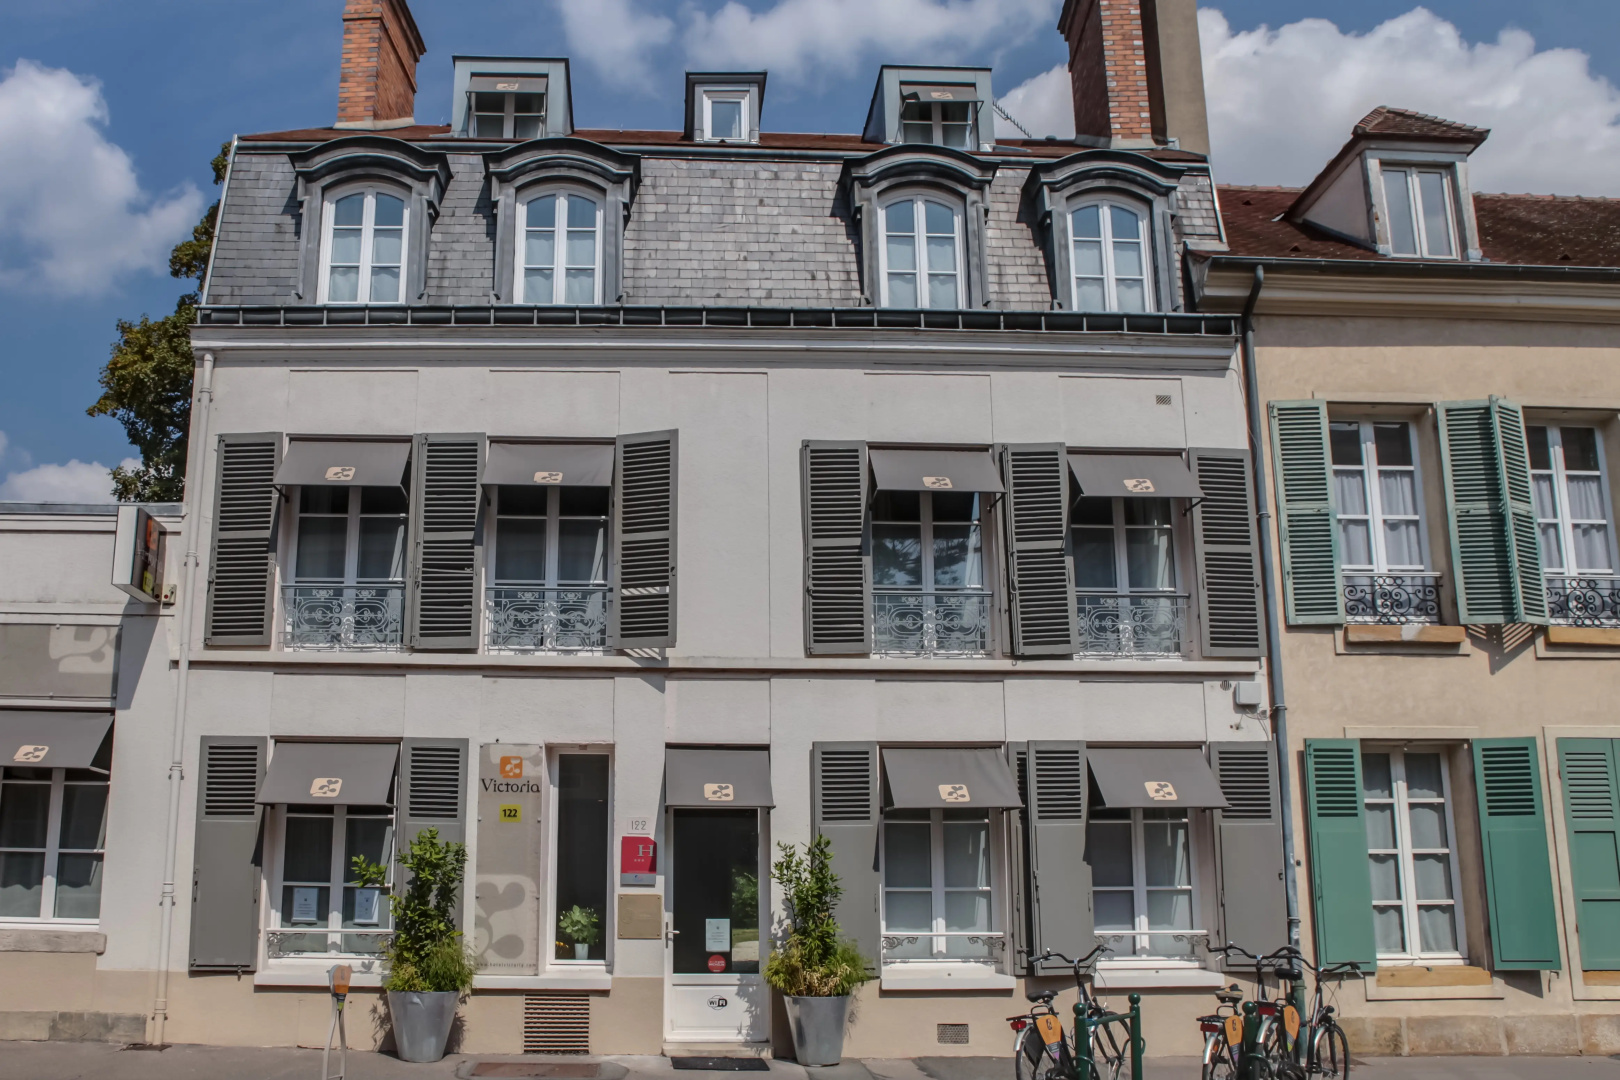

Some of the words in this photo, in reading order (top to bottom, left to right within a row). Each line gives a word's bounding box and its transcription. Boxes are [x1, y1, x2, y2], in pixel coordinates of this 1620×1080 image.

[481, 778, 541, 793] Victoria
[502, 808, 518, 818] 122
[631, 820, 647, 831] 122
[637, 844, 655, 857] H
